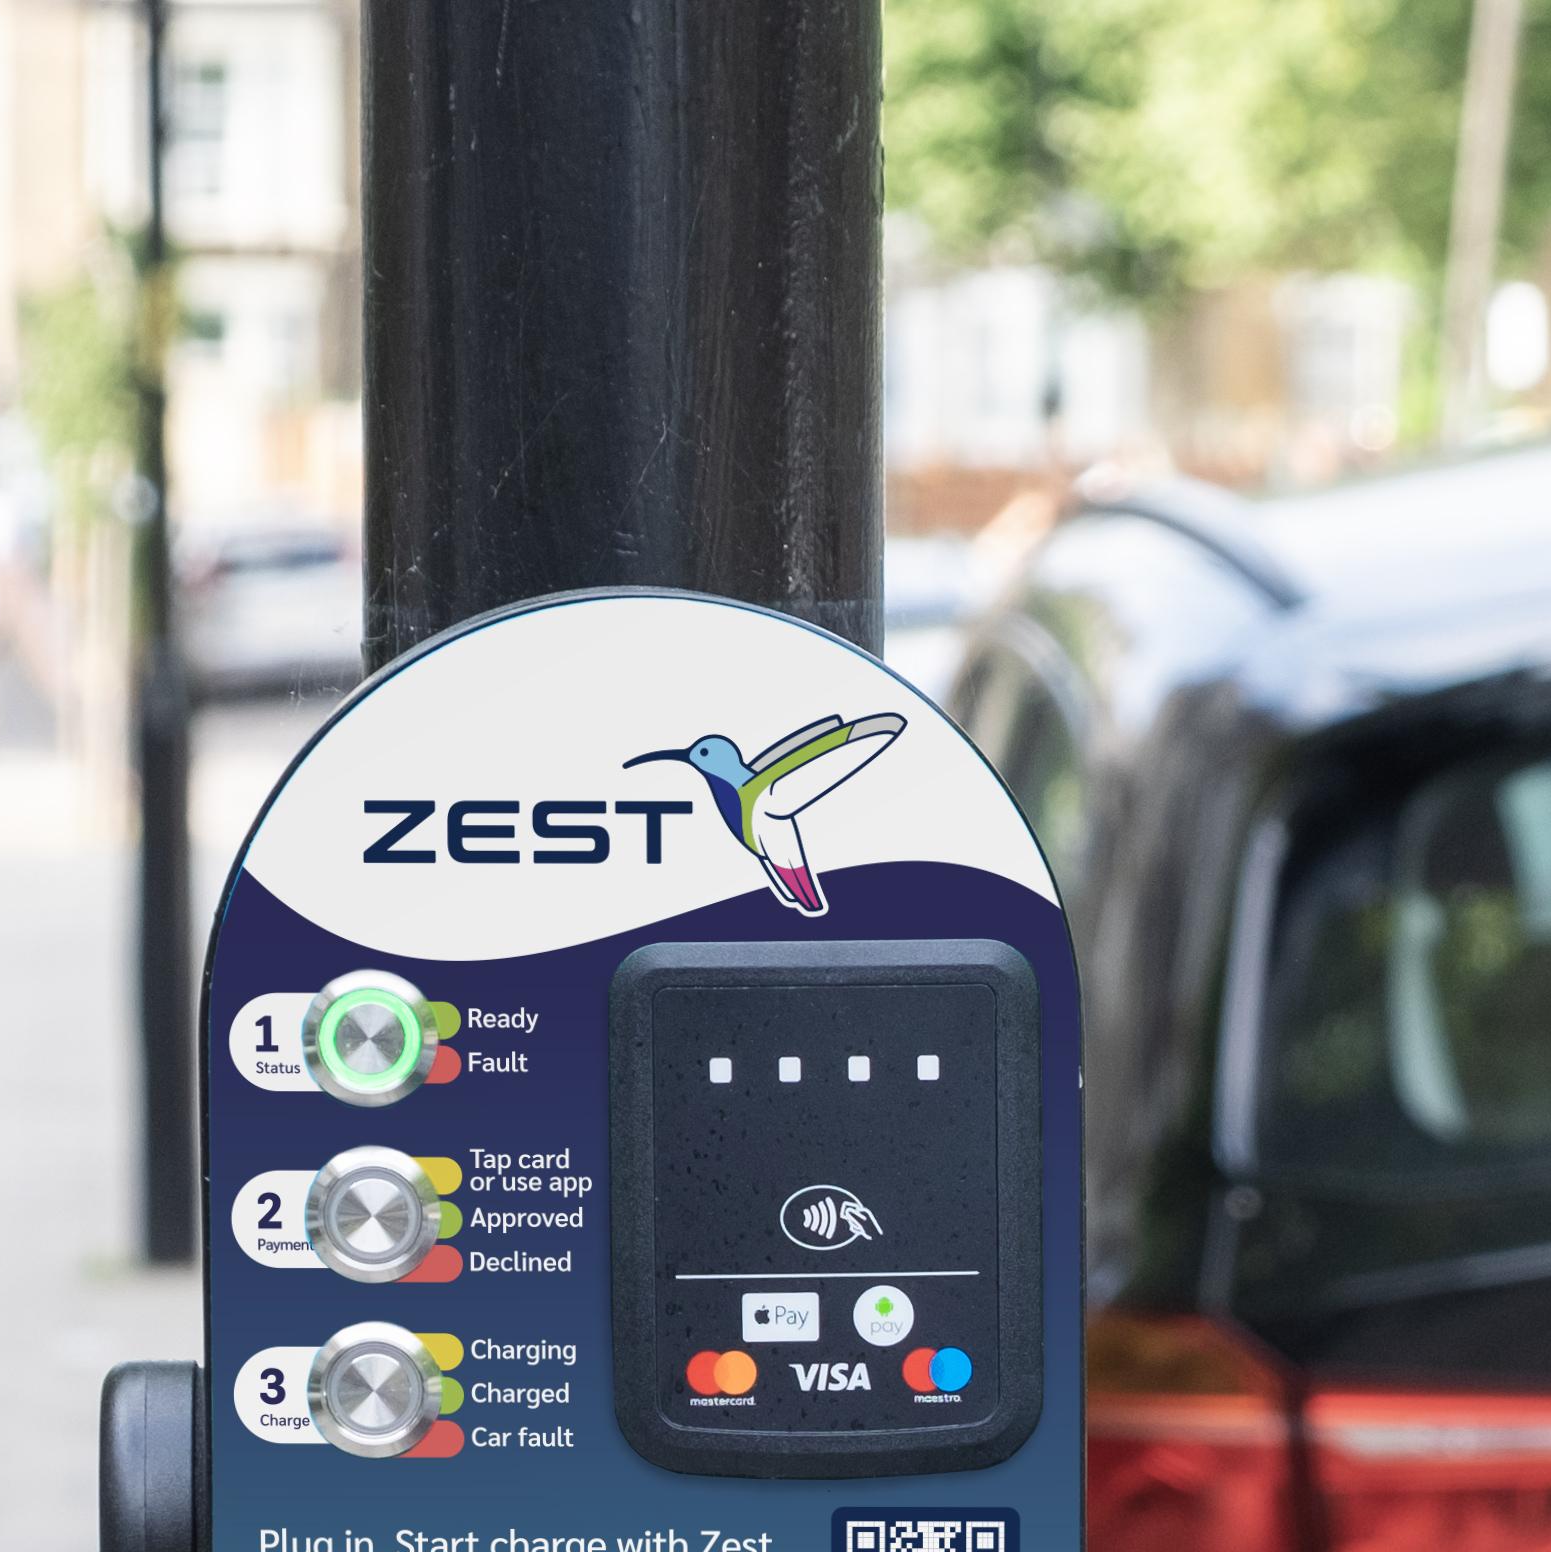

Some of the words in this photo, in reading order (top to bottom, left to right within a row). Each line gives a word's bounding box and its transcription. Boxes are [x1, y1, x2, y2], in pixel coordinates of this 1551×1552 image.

[362, 799, 694, 865] ZEST
[468, 1006, 539, 1034] Ready
[254, 1015, 279, 1053] 1
[255, 1061, 301, 1075] Status
[468, 1050, 529, 1073] Fault
[469, 1148, 512, 1173] Tap
[518, 1147, 570, 1169] card
[469, 1176, 496, 1192] or
[502, 1176, 543, 1192] use
[548, 1176, 593, 1198] app
[257, 1191, 283, 1230] 2
[470, 1206, 583, 1234] Approved
[470, 1250, 572, 1273] Declined
[775, 1305, 809, 1330] Pay
[869, 1318, 904, 1336] pay
[470, 1338, 577, 1366] Charging
[259, 1367, 287, 1406] 3
[788, 1362, 872, 1392] VISA
[471, 1381, 570, 1410] Charged
[689, 1395, 755, 1407] mastercard
[913, 1393, 962, 1403] maestro
[259, 1412, 310, 1431] Charge
[471, 1426, 513, 1448] Car
[517, 1425, 574, 1448] fault
